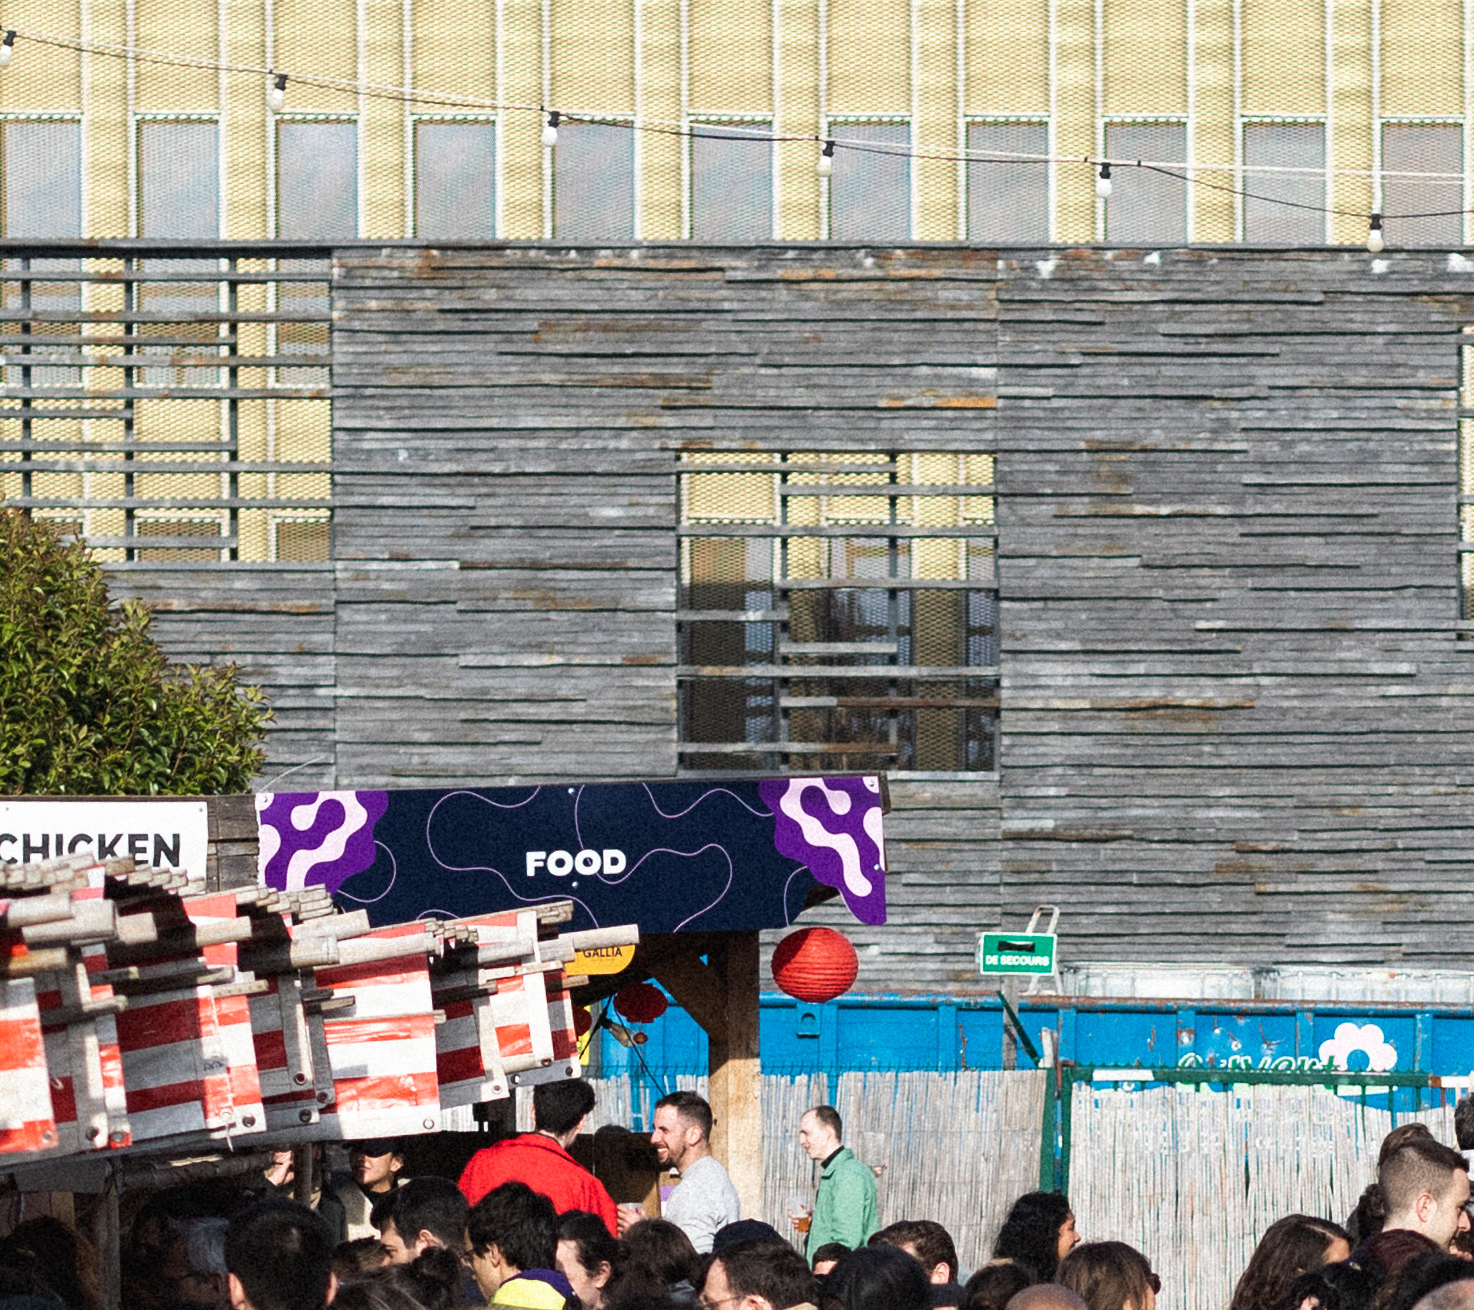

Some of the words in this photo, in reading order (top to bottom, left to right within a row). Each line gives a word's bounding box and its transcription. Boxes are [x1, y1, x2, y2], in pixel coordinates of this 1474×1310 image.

[526, 849, 627, 877] FOOD
[583, 946, 623, 958] GALLIA
[985, 955, 999, 965] DE
[1000, 955, 1050, 966] SECOURS
